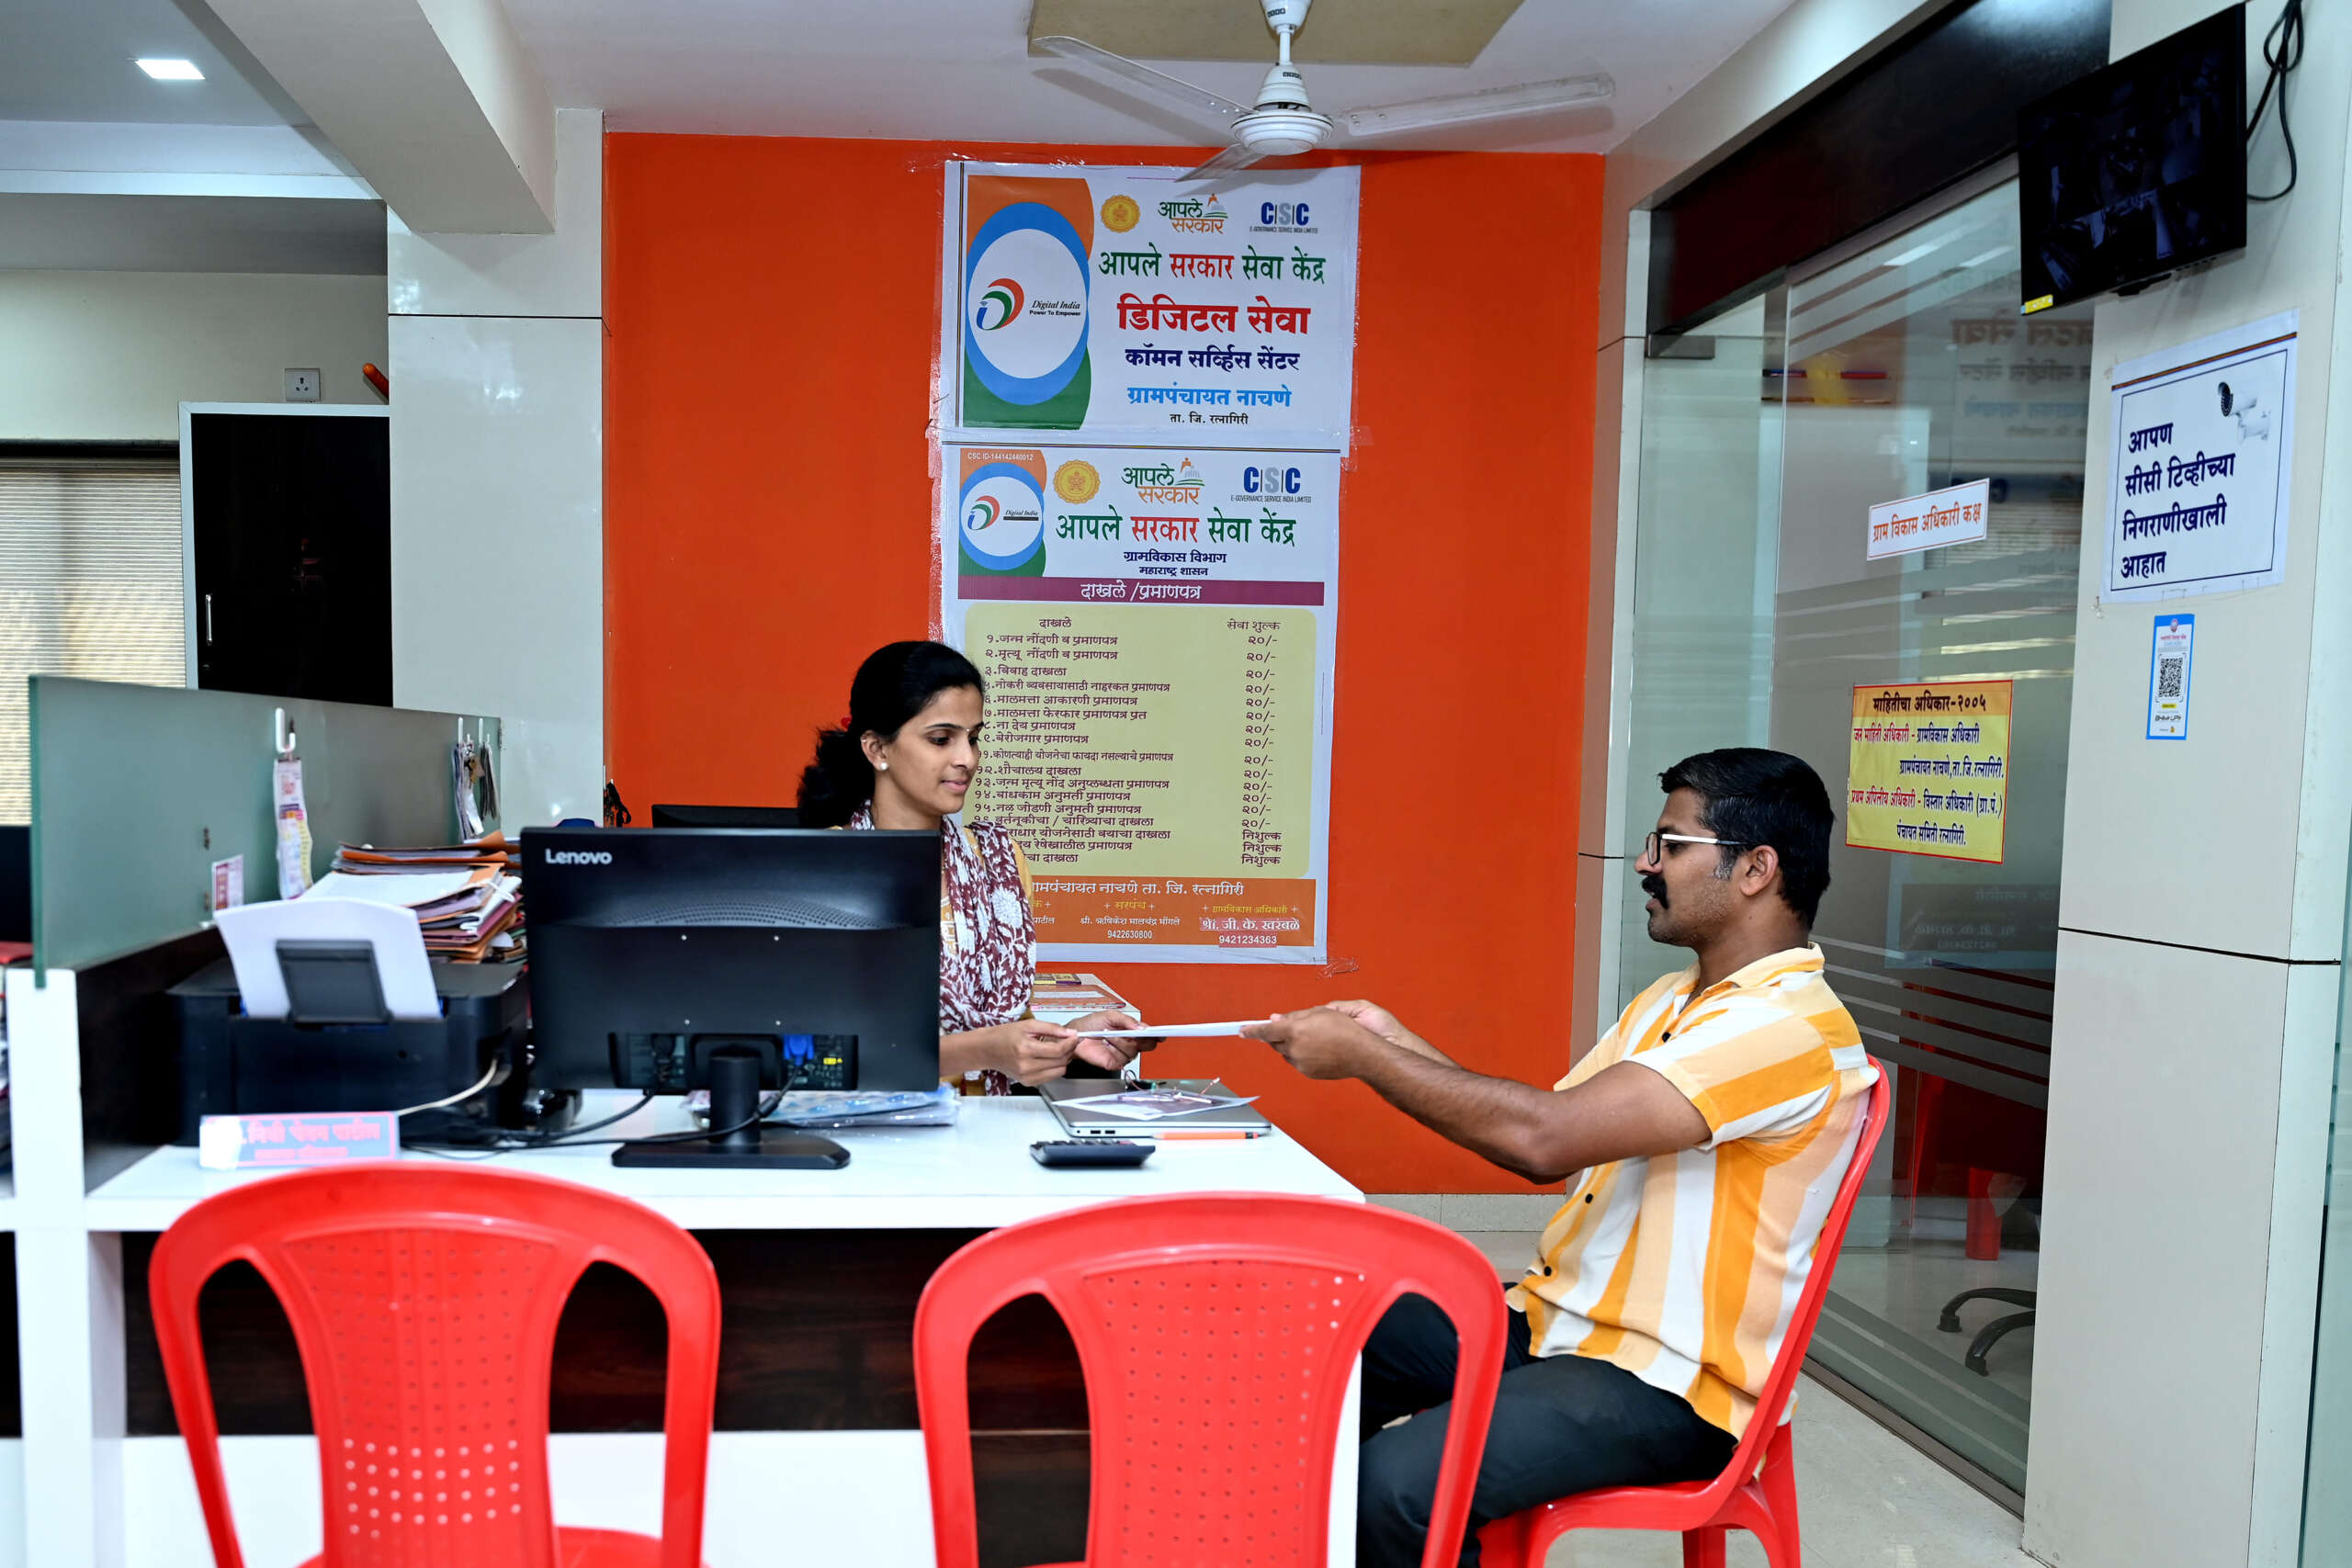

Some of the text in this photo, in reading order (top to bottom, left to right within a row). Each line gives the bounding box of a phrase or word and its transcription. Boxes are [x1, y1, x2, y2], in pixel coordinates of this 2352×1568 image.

[1158, 198, 1203, 219] आपले
[1172, 218, 1224, 233] सरकार
[1099, 243, 1326, 284] आपले सरकार सेवा केंद्र
[1033, 300, 1080, 310] Digital India
[1117, 294, 1310, 334] डिजिटल सेवा
[1125, 344, 1300, 371] कॉमन सर्व्हिस सेंटर
[1128, 382, 1292, 406] ग्रामपंचायत नाचणे
[1170, 412, 1249, 424] ता. जि. रत्नागिरी
[2129, 423, 2173, 453] आपण
[1122, 463, 1174, 487] आपले
[2125, 451, 2235, 497] सीसी टिव्हीच्या
[1137, 486, 1200, 504] सरकार
[1873, 502, 1982, 542] ग्राम विकास अधिकारी कक्ष
[2122, 493, 2227, 540] निगराणीखाली
[1057, 505, 1296, 547] आपले सरकार सेवा केंद्र
[1124, 548, 1227, 563] ग्रामविकास विभाग
[1139, 567, 1208, 577] महाराष्ट्र शासन
[2121, 551, 2166, 579] आहात
[1080, 581, 1126, 599] दाखले
[1039, 617, 1071, 628] दाखले
[1227, 618, 1281, 633] सेवा शुल्क
[1026, 632, 1058, 645] नोंदणी
[1073, 637, 1117, 647] प्रमाणपत्र
[1026, 648, 1058, 660] नोंदणी
[1073, 650, 1117, 660] प्रमाणपत्र
[1031, 667, 1067, 676] दाखला
[1026, 680, 1088, 691] व्यवसायासाठी
[1132, 683, 1170, 693] प्रमाणपत्र
[1044, 694, 1138, 705] आकारणी प्रमाणपत्र
[1873, 690, 1986, 714] माहितीचा अधिकार-२००५
[1044, 707, 1080, 718] फेरफार
[1083, 710, 1127, 720] प्रमाणपत्र
[1012, 719, 1028, 730] देय
[1031, 722, 1076, 731] प्रमाणपत्र
[1864, 722, 1882, 743] माहिती
[1883, 724, 1909, 743] अधिकारी
[1917, 722, 1949, 742] ग्रामविकास
[1951, 722, 1980, 743] अधिकारी
[1044, 735, 1089, 744] प्रमाणपत्र
[1035, 749, 1173, 761] योजनेचा फायदा नसल्याचे प्रमाणपत्र
[1046, 767, 1081, 775] दाखला
[1900, 755, 1930, 775] ग्रामपंचायत
[1046, 776, 1065, 788] नोंद
[1126, 781, 1169, 789] प्रमाणपत्र
[1044, 789, 1131, 803] अनुमती प्रमाणपत्र
[1851, 790, 1864, 804] प्रथम
[1891, 786, 1916, 807] अधिकारी
[1924, 788, 1943, 810] विस्तार
[1945, 790, 1973, 812] अधिकारी
[1017, 802, 1141, 816] जोडणी अनुमती प्रमाणपत्र
[1118, 818, 1154, 827] दाखला
[1039, 827, 1095, 838] योजनेसाठी
[1136, 830, 1170, 840] दाखला
[1242, 830, 1282, 843] निशुल्क
[1896, 819, 1917, 839] पंचायत
[1918, 821, 1938, 843] समिती
[1088, 842, 1132, 851] प्रमाणपत्र
[1243, 842, 1282, 855] निशुल्क
[545, 849, 612, 864] Lenovo
[1043, 854, 1079, 863] दाखला
[1241, 854, 1281, 867] निशुल्क
[1032, 879, 1244, 896] ामपंचायत नाचणे ता. जि. रत्नागिरी
[1219, 935, 1277, 944] 9421234363
